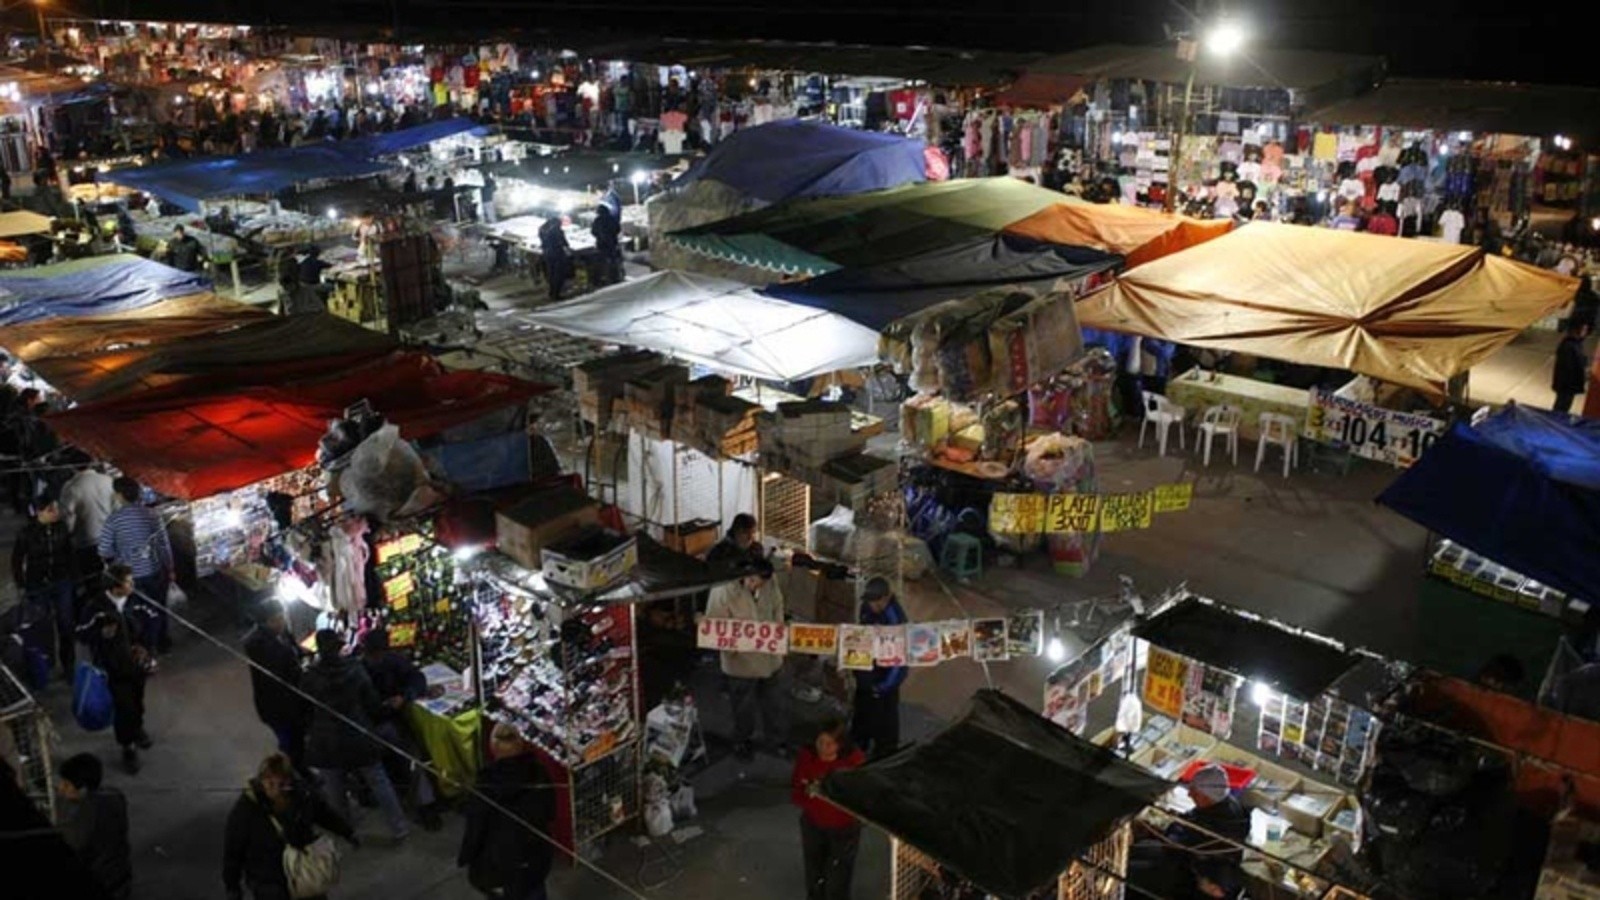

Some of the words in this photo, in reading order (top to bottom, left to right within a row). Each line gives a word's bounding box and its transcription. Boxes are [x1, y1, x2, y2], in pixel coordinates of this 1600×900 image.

[701, 619, 785, 640] JUEGOS
[717, 637, 738, 649] DE
[755, 638, 778, 652] PC
